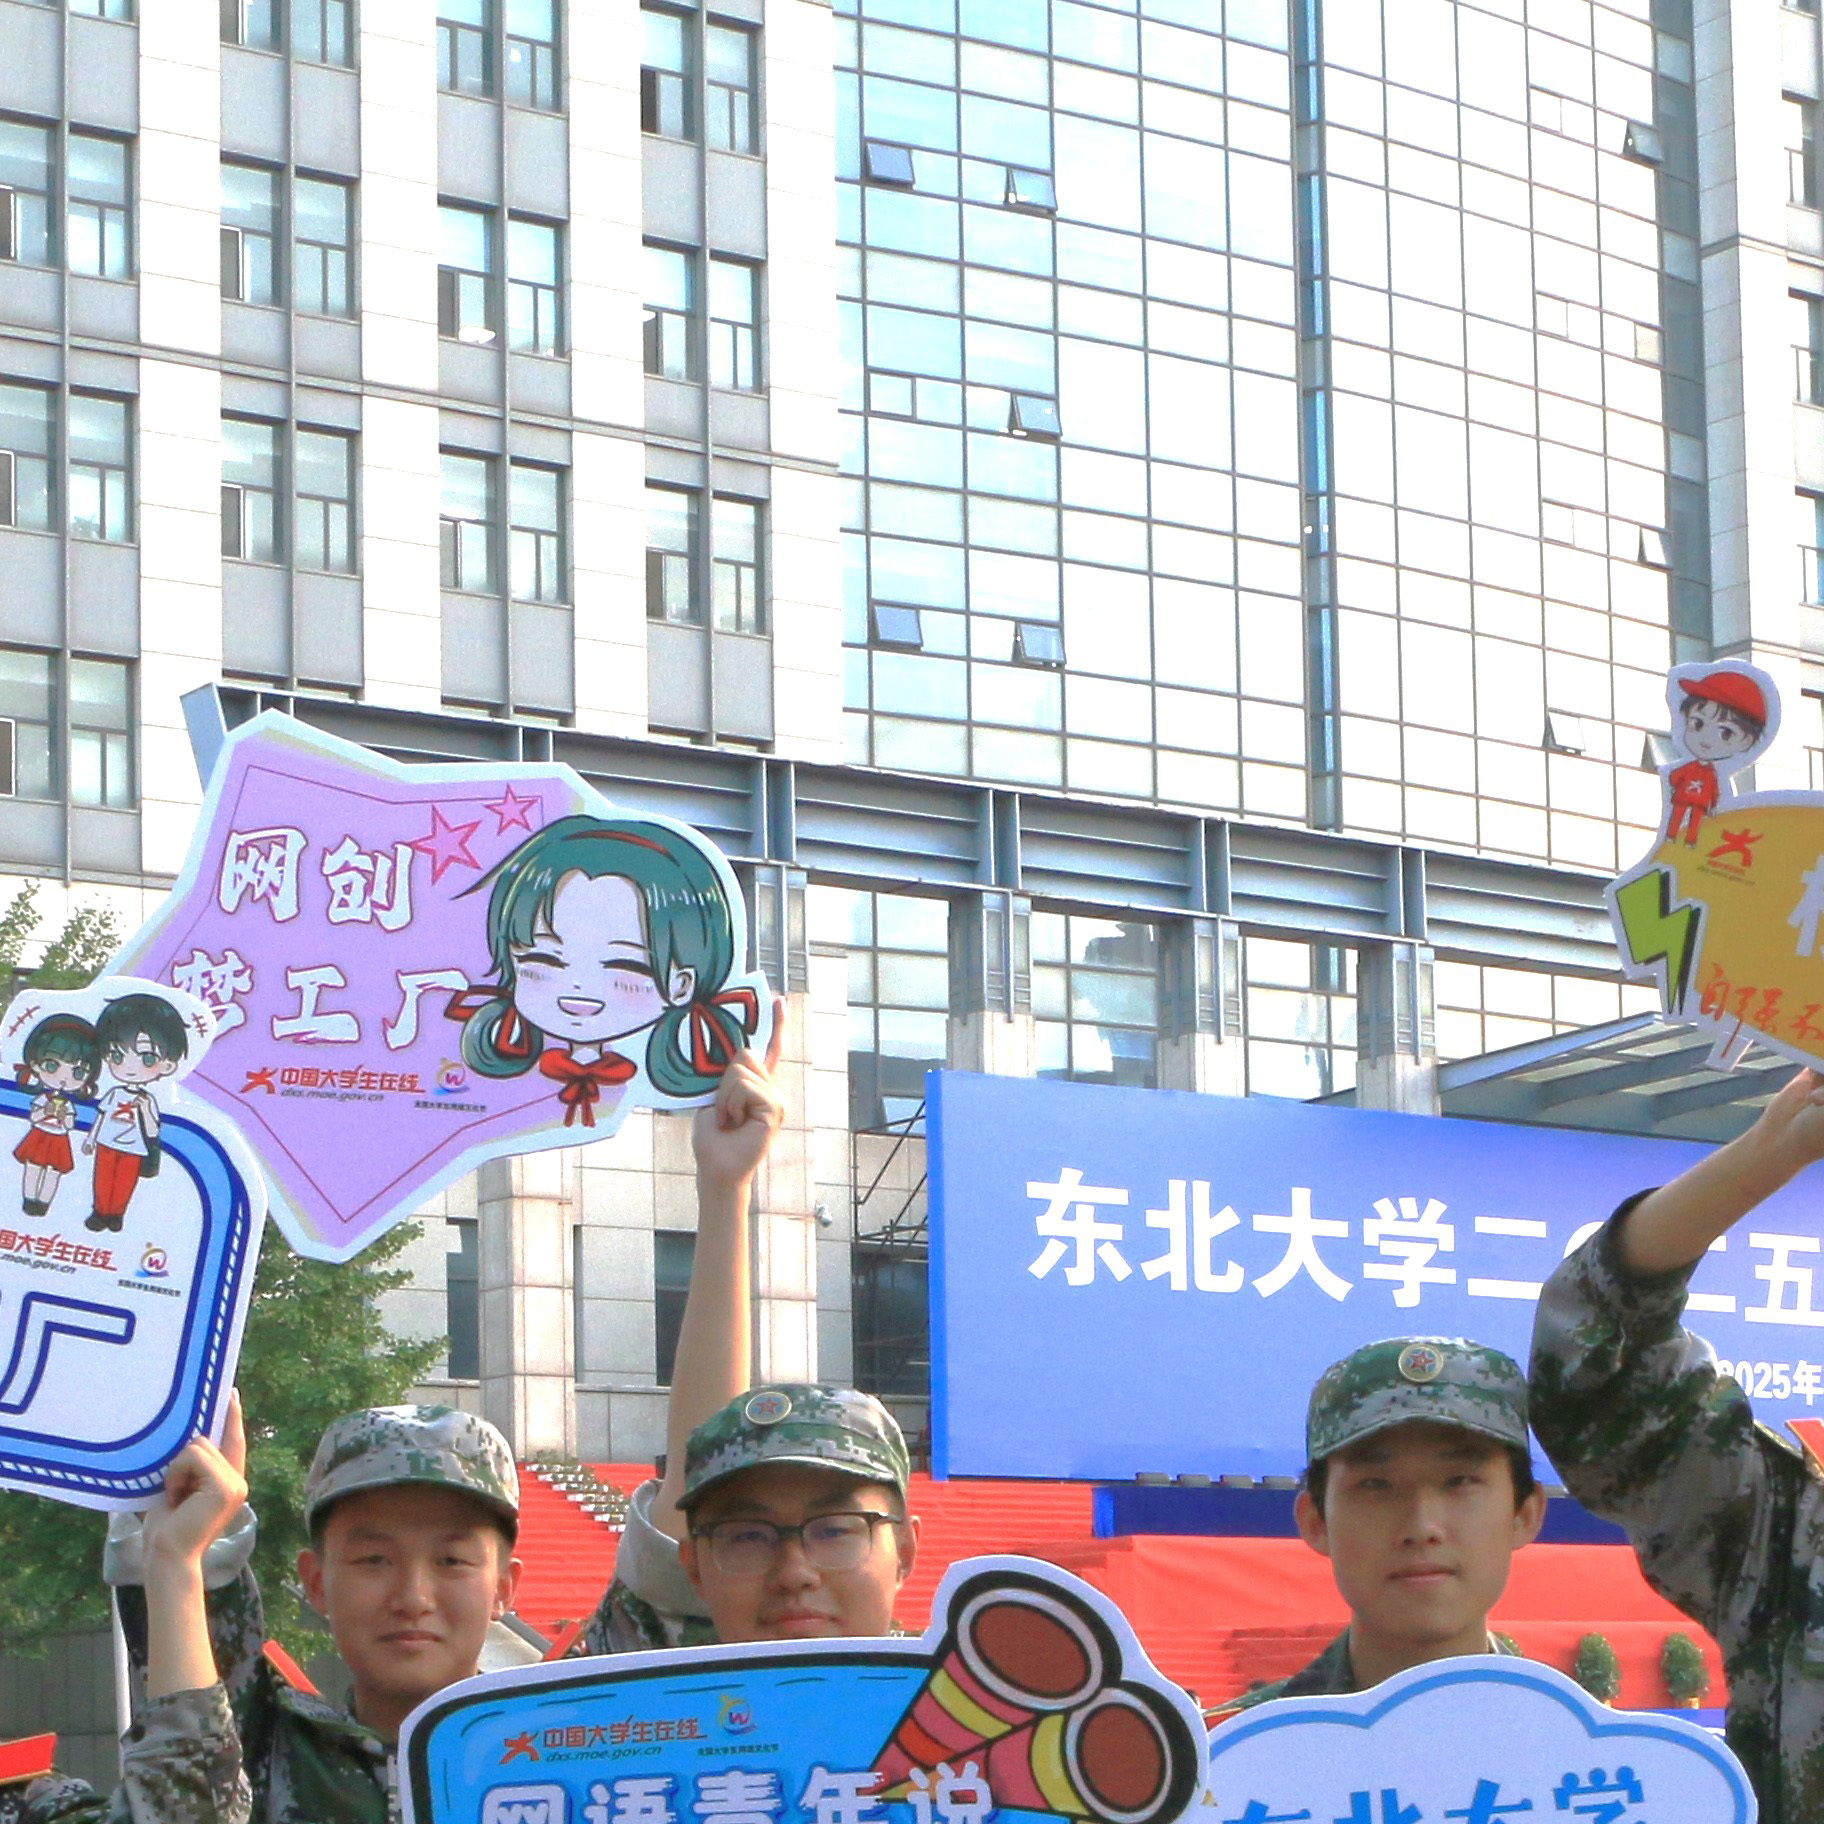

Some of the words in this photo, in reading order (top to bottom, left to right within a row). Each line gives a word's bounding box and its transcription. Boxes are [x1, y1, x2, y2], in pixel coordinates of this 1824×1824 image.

[219, 827, 414, 931] 网创
[171, 948, 468, 1052] 梦工厂
[280, 1065, 426, 1095] 中国大学生在线
[543, 1714, 708, 1748] 中国大学生在线
[545, 1746, 662, 1762] dxs.moe.gov.cn
